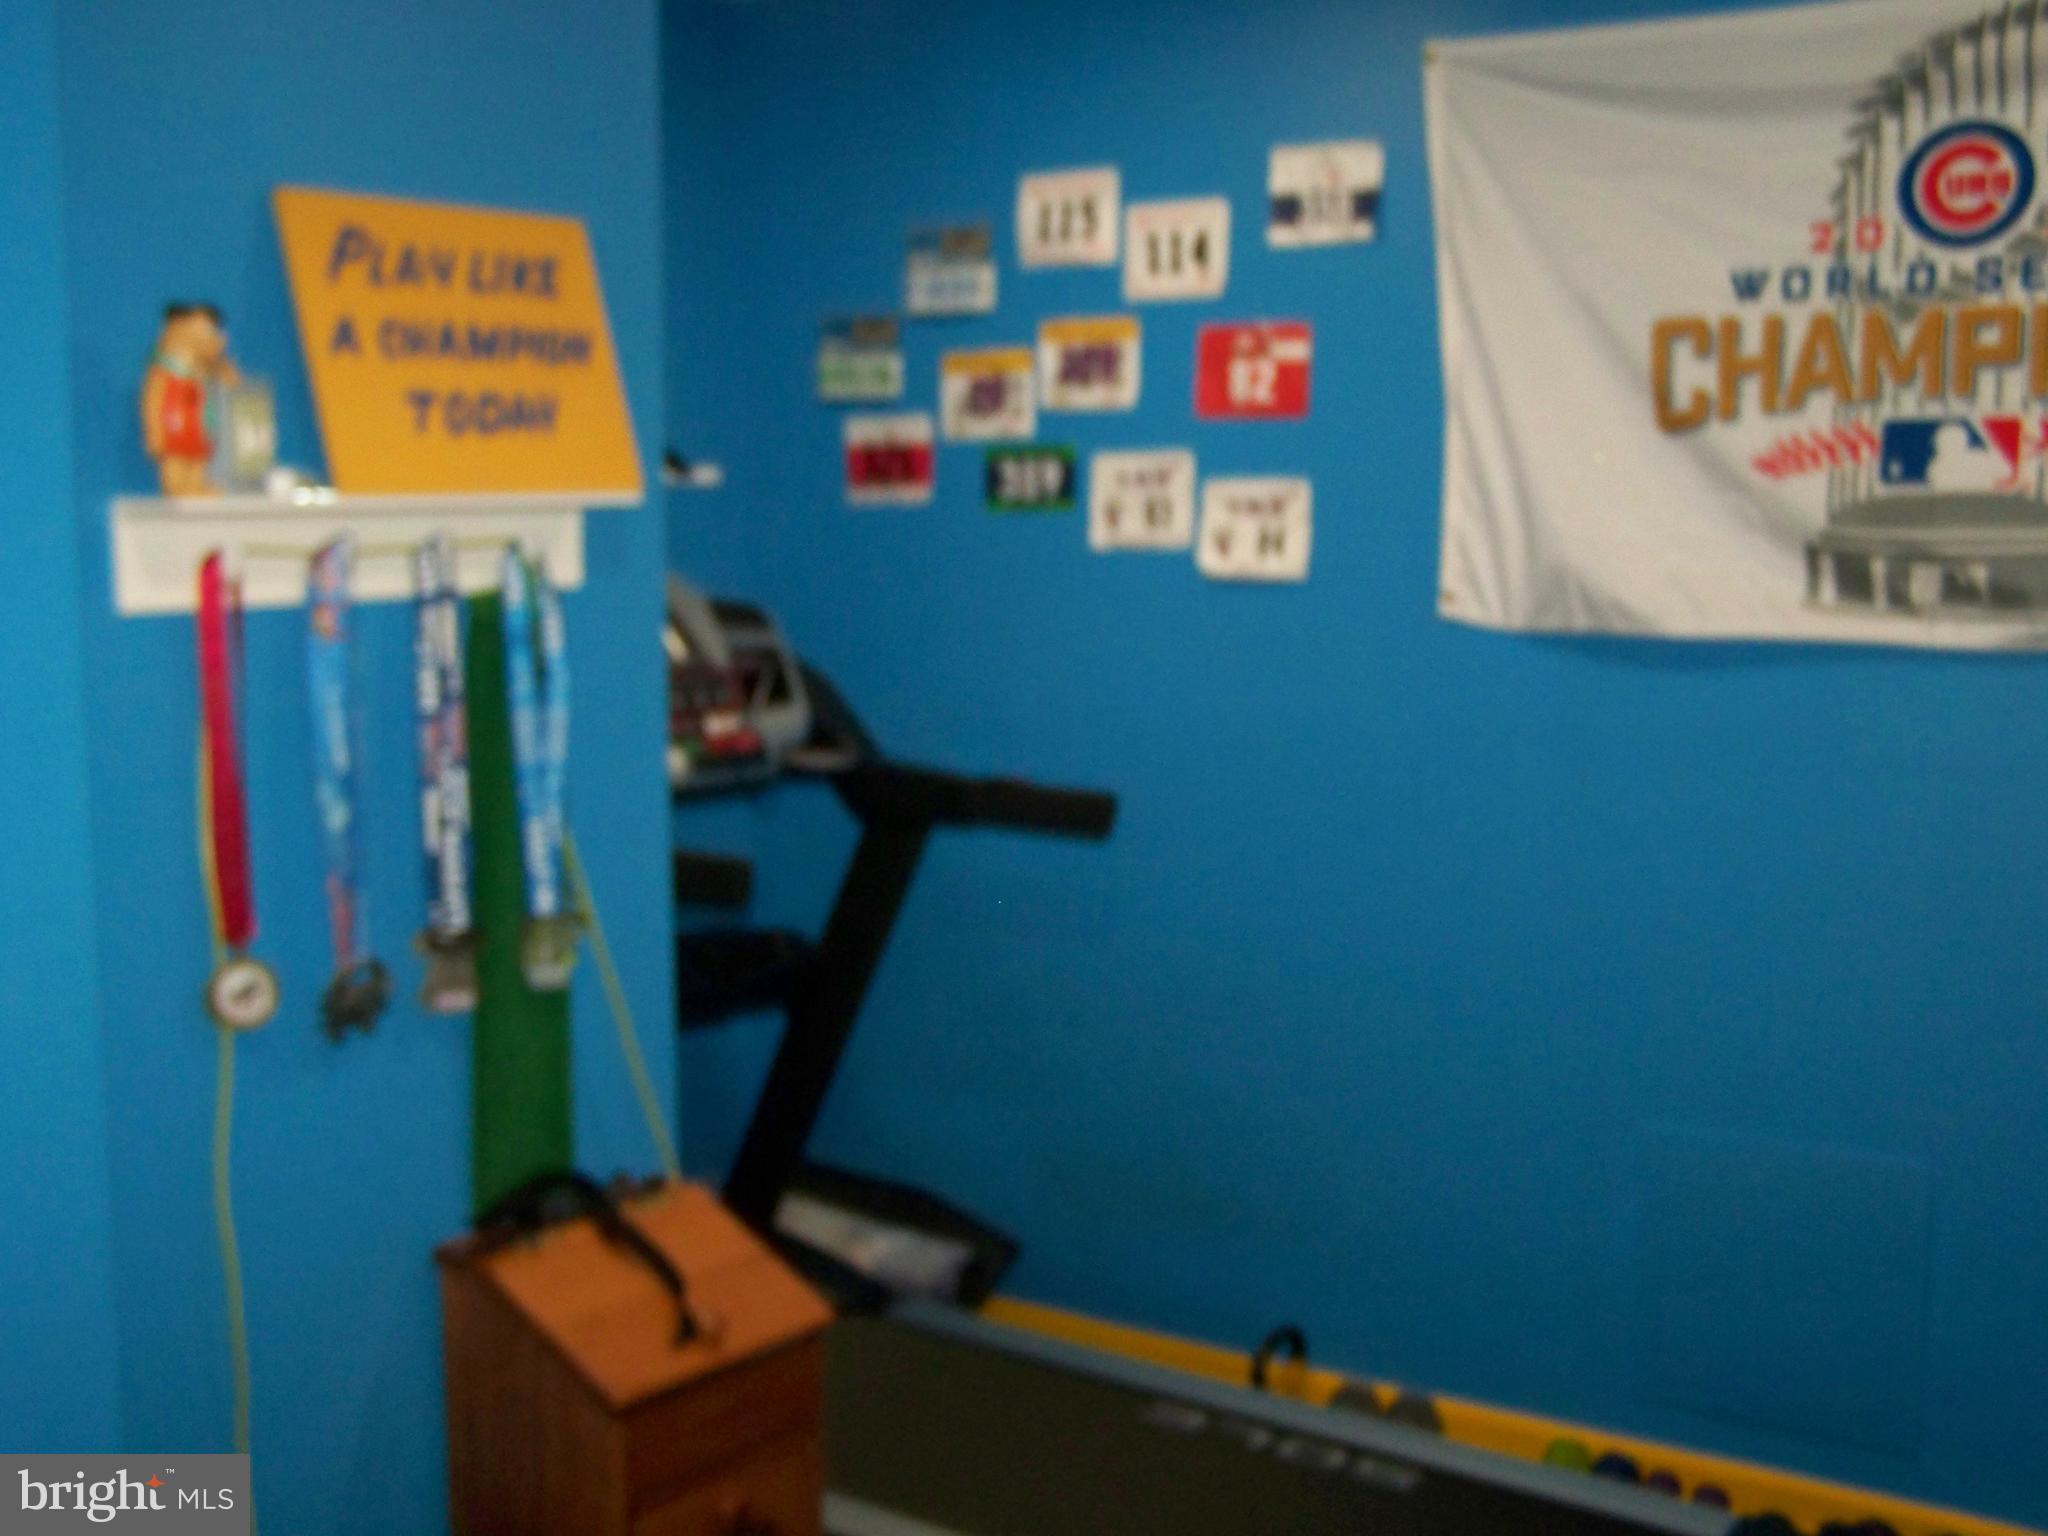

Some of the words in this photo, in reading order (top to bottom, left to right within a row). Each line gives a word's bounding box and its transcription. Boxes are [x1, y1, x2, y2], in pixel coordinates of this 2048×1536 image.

[326, 222, 459, 288] PLAY
[467, 250, 559, 299] LIKE
[1729, 259, 1937, 301] WORLD
[331, 313, 360, 353] A
[377, 317, 592, 367] CHAMPION
[406, 388, 559, 437] TODAY
